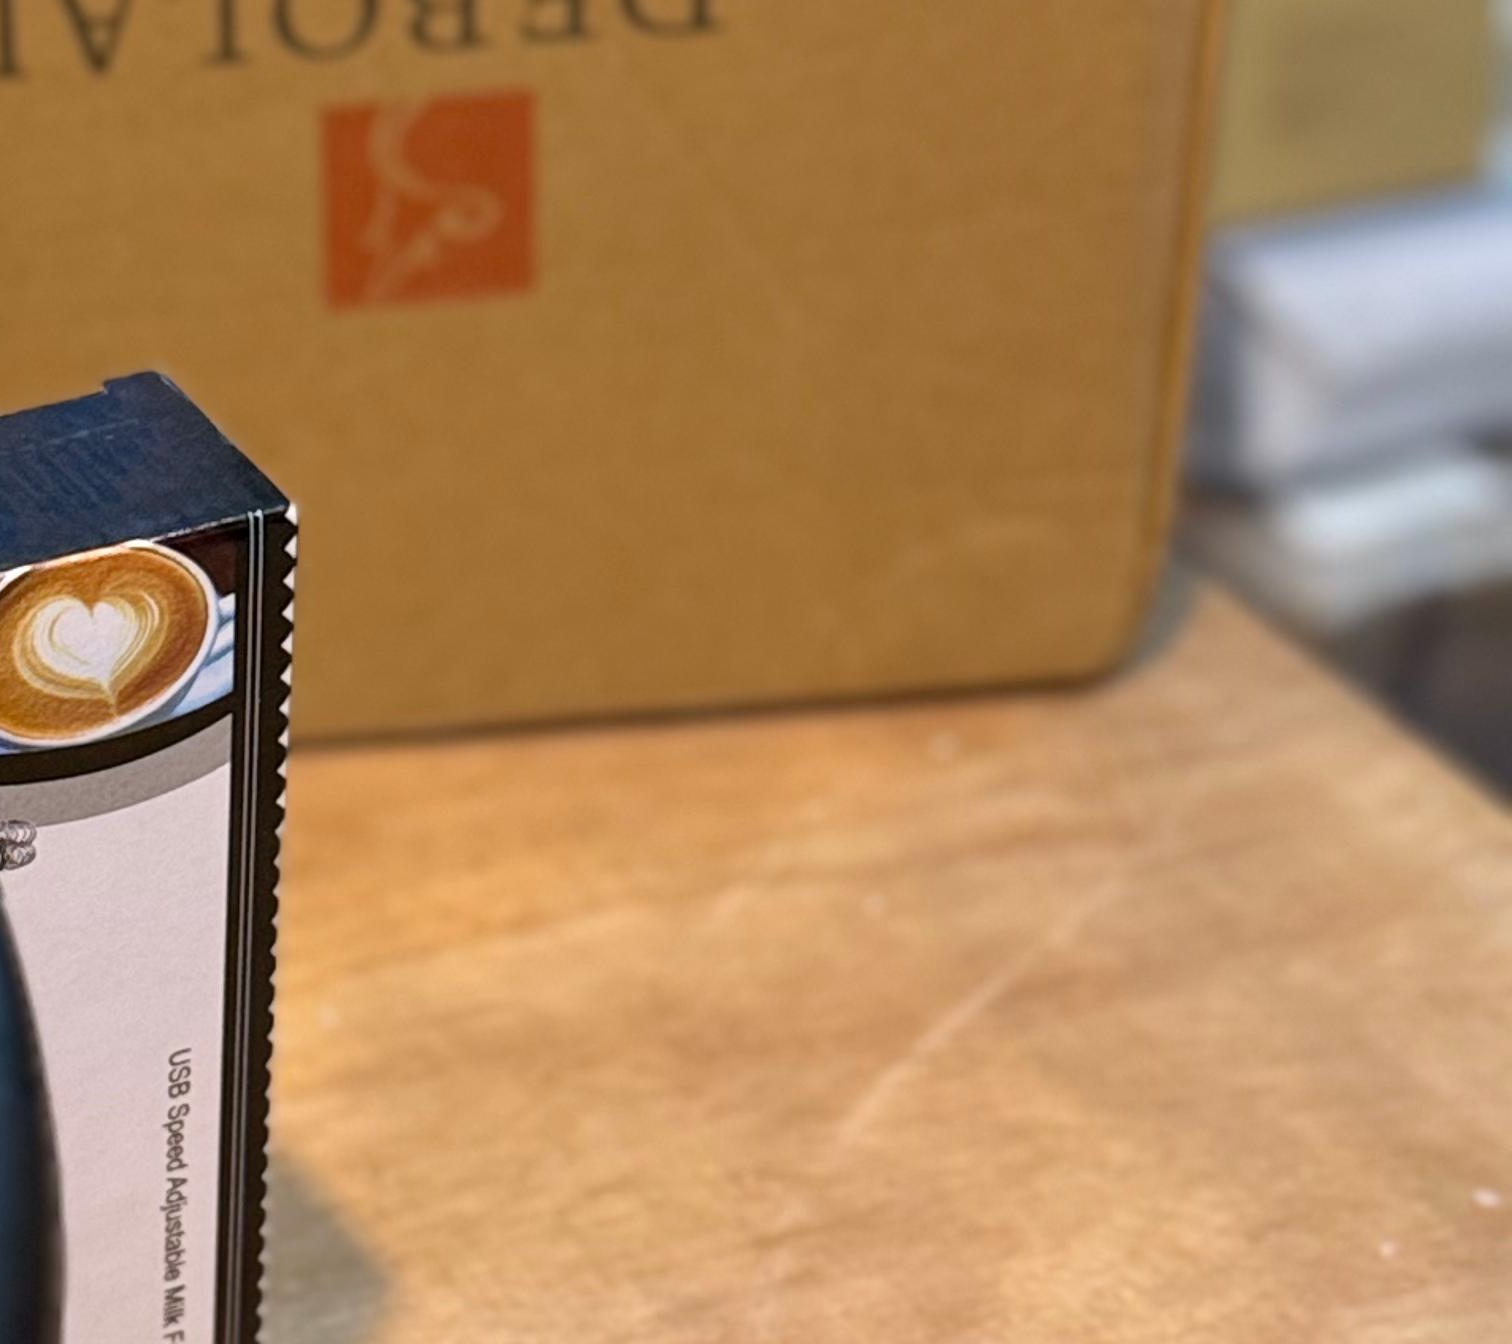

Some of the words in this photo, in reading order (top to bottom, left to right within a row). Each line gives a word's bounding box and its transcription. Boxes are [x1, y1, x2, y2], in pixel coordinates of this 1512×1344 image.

[167, 1047, 192, 1099] USB
[161, 1103, 190, 1172] Speed
[159, 1177, 189, 1282] Adjustable
[162, 1284, 186, 1328] Milk
